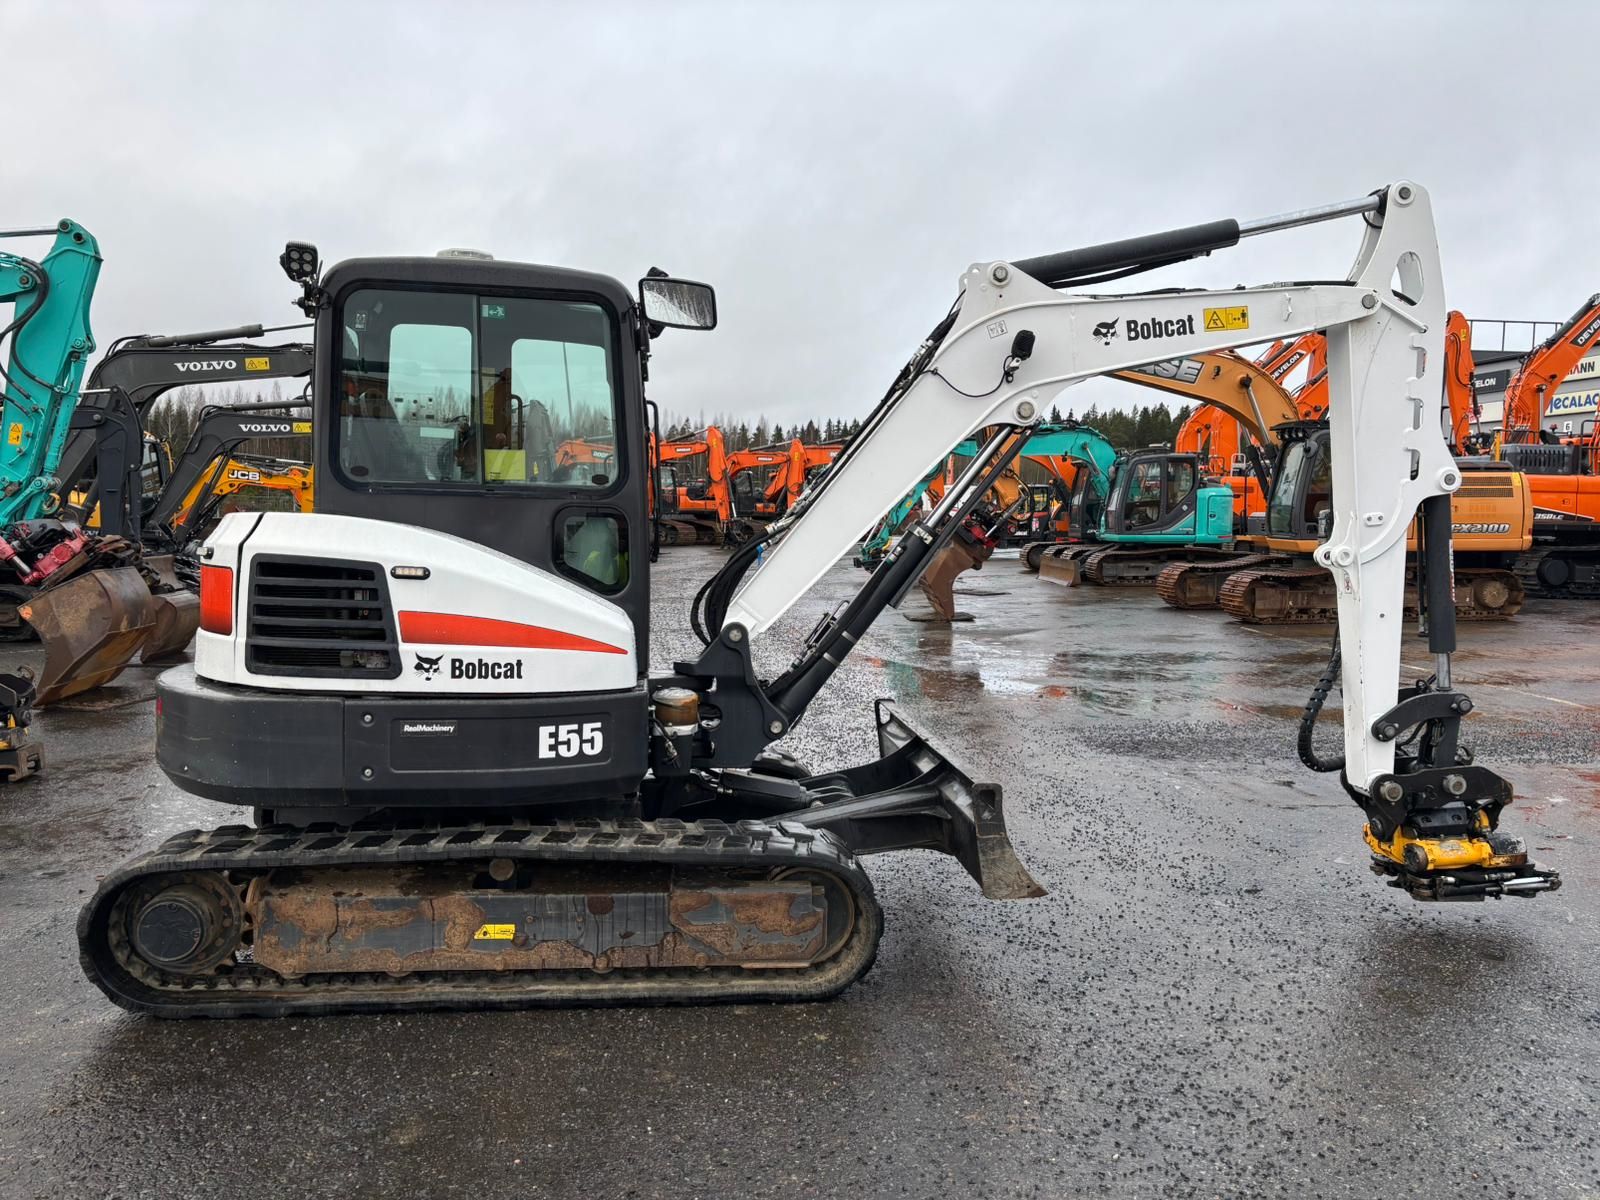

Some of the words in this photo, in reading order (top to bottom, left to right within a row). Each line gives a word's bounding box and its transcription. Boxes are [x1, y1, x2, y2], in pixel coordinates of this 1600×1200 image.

[1126, 314, 1195, 341] Bobcat
[174, 360, 237, 371] VOLVO
[1568, 361, 1595, 375] ANN
[238, 424, 290, 432] VOLVO
[228, 470, 260, 481] JCB
[451, 658, 523, 680] Bobcat
[403, 723, 455, 733] RealMachinery
[538, 721, 604, 760] E55
